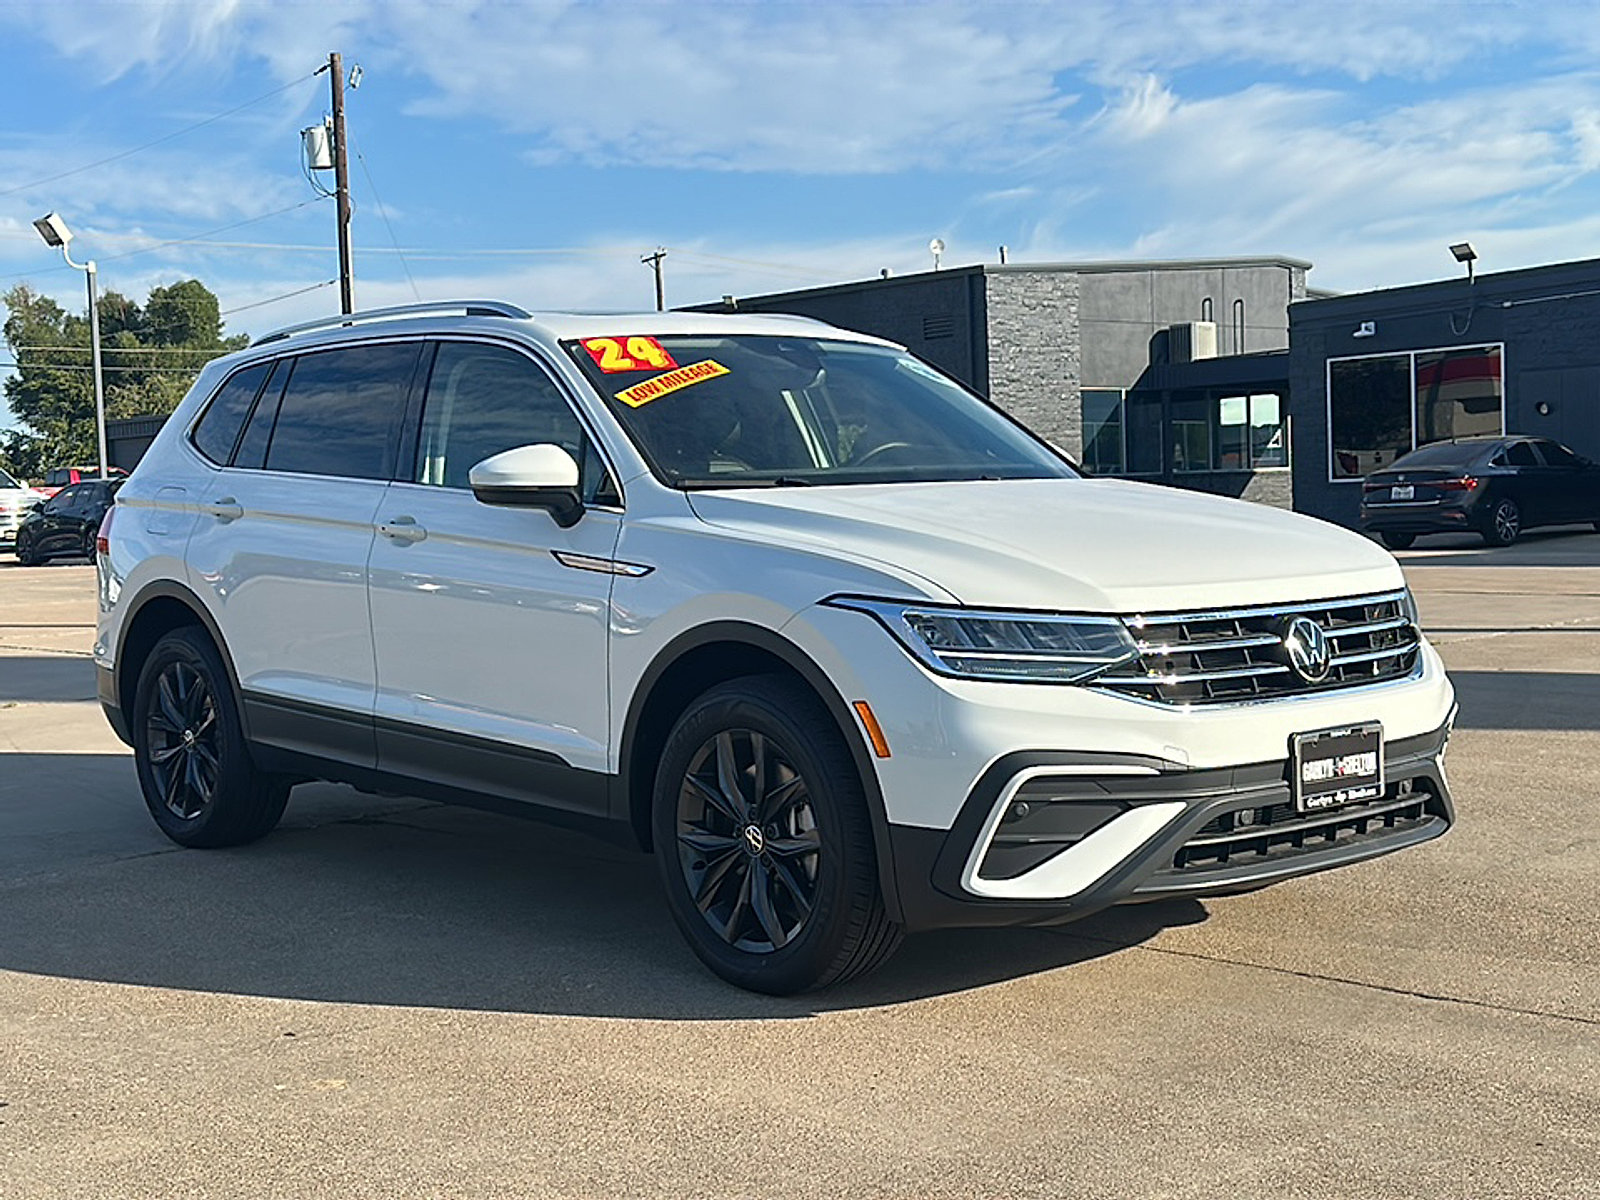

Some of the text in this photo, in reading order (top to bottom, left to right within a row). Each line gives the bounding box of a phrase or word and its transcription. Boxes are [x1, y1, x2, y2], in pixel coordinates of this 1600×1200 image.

[586, 338, 669, 368] 24
[626, 363, 719, 402] LOW MILEAGE
